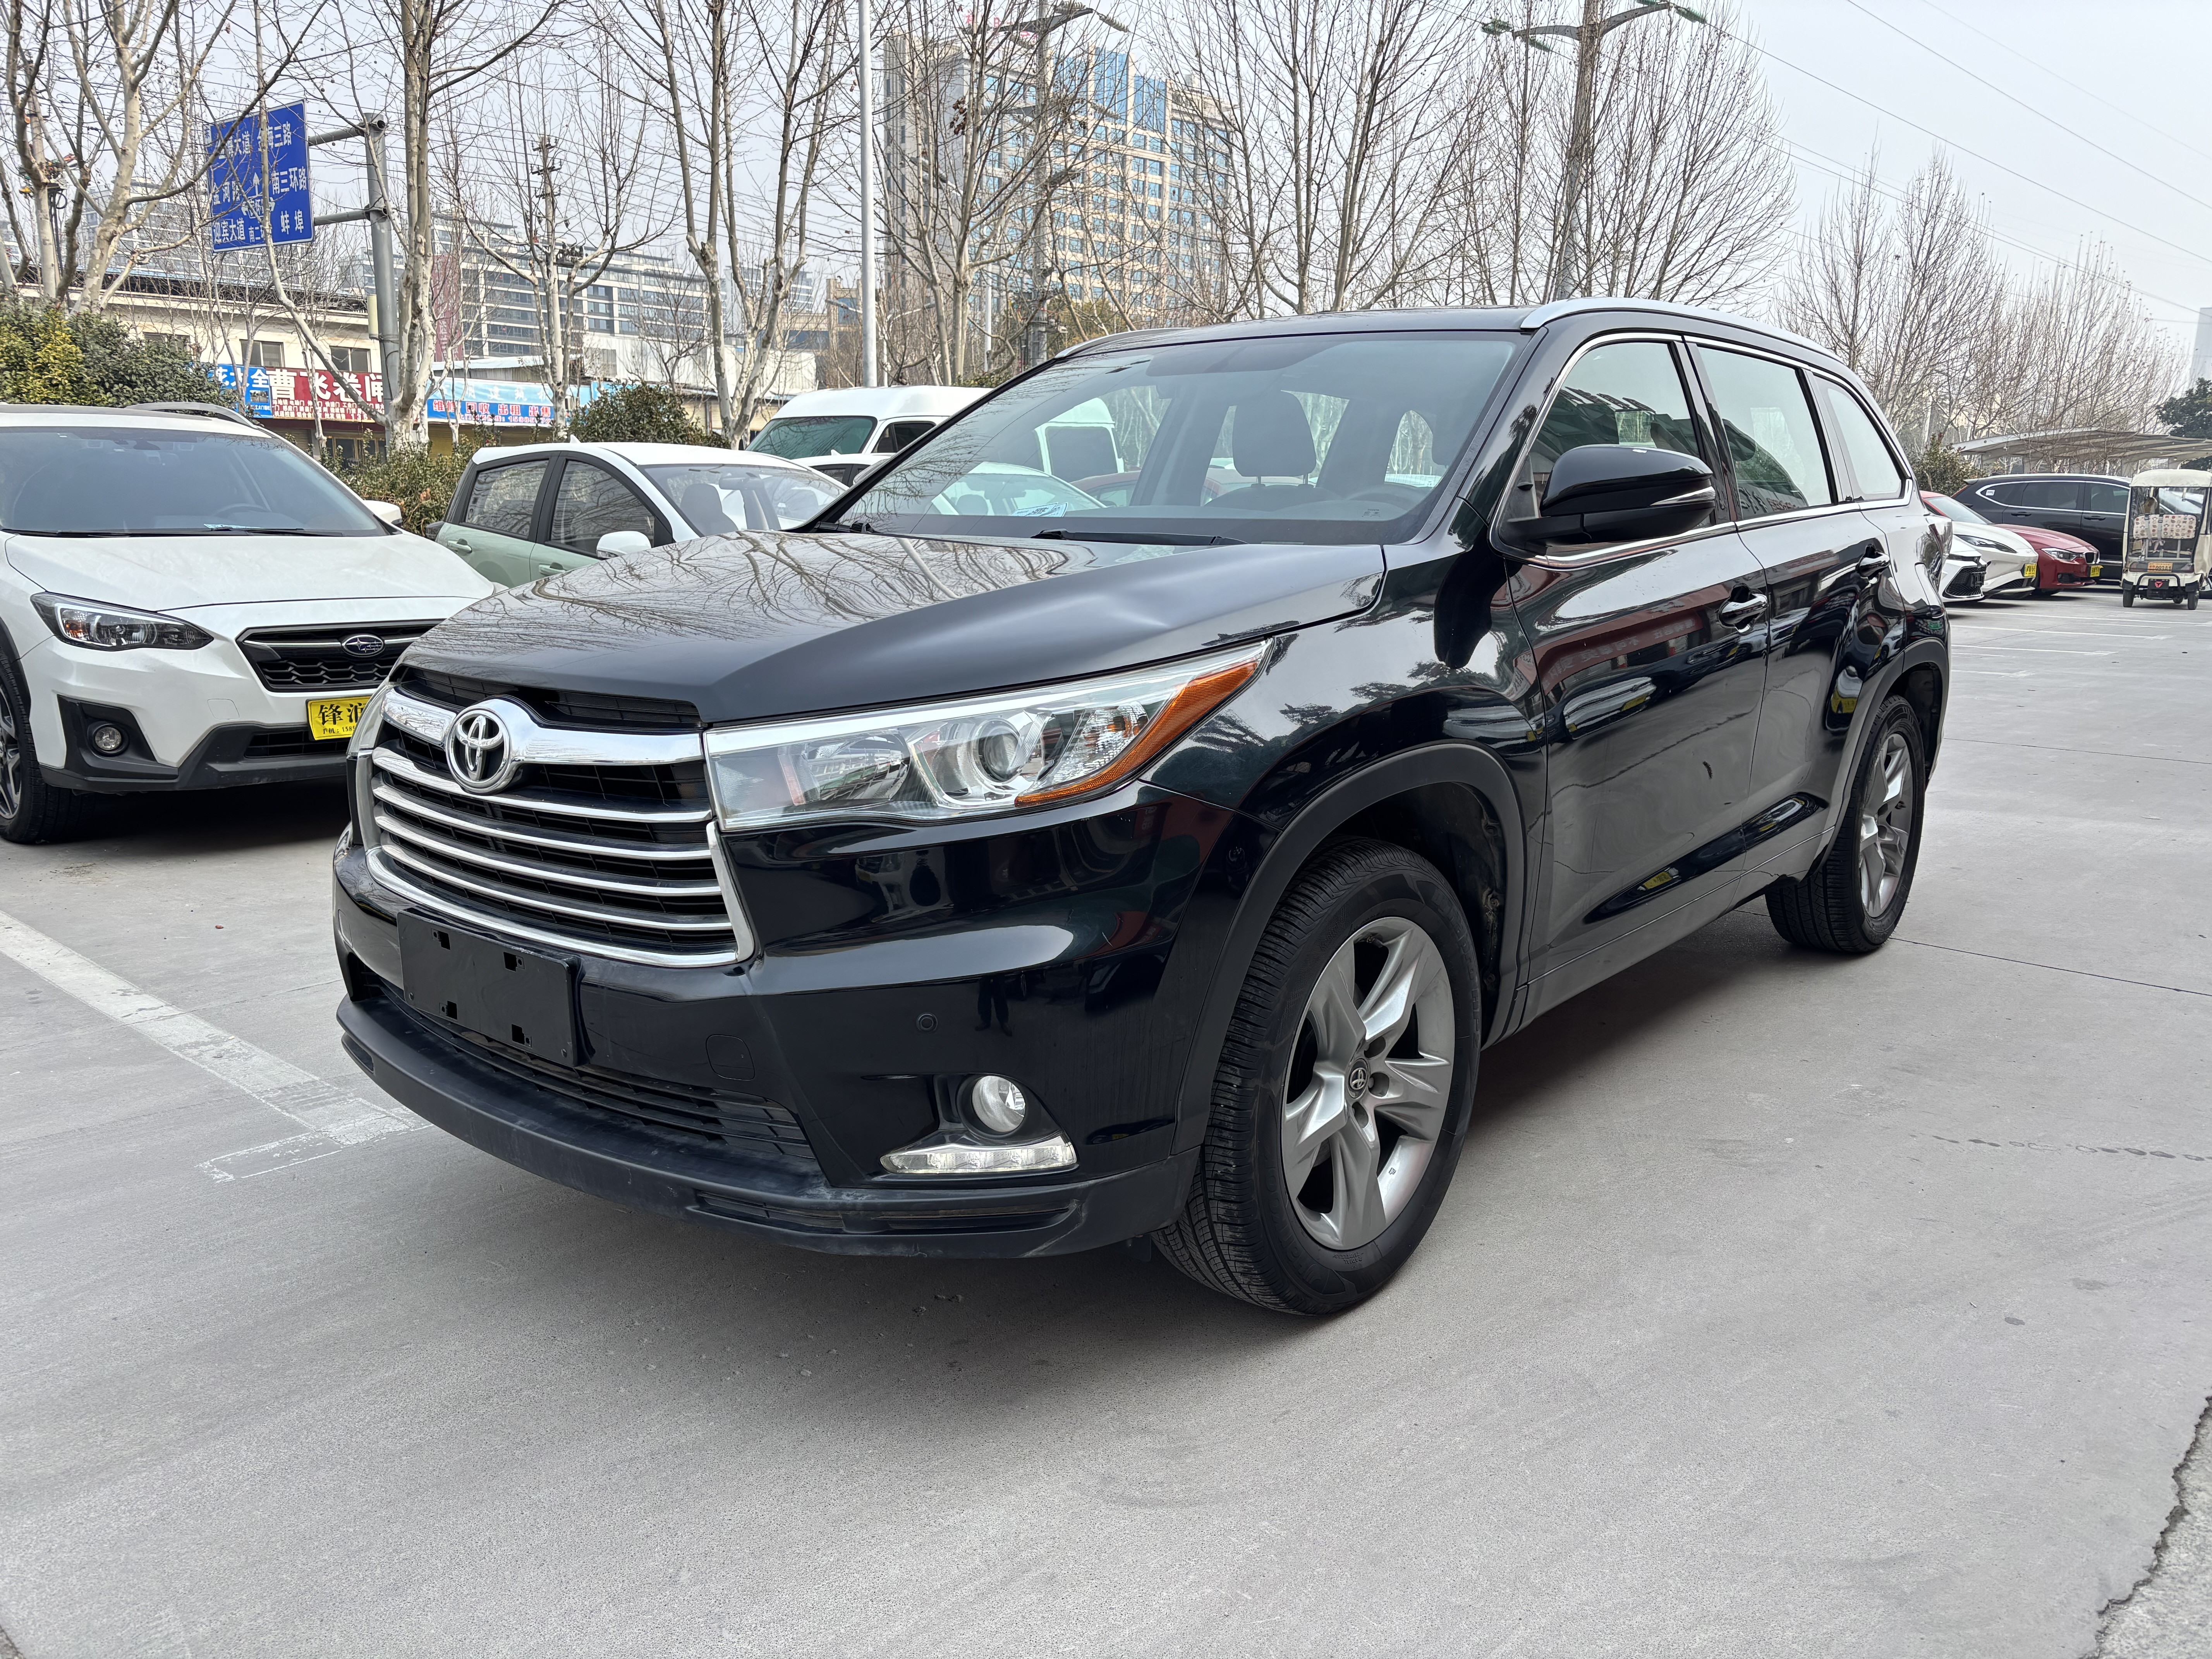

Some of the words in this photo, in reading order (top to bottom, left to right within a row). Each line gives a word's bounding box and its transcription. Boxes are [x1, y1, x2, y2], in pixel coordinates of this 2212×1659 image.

[271, 166, 307, 195] 南三环路
[213, 217, 246, 243] 迎宾大道
[280, 209, 304, 235] 蚌埠
[465, 402, 489, 414] 回收
[498, 404, 520, 416] 出租
[529, 406, 551, 418] 出售
